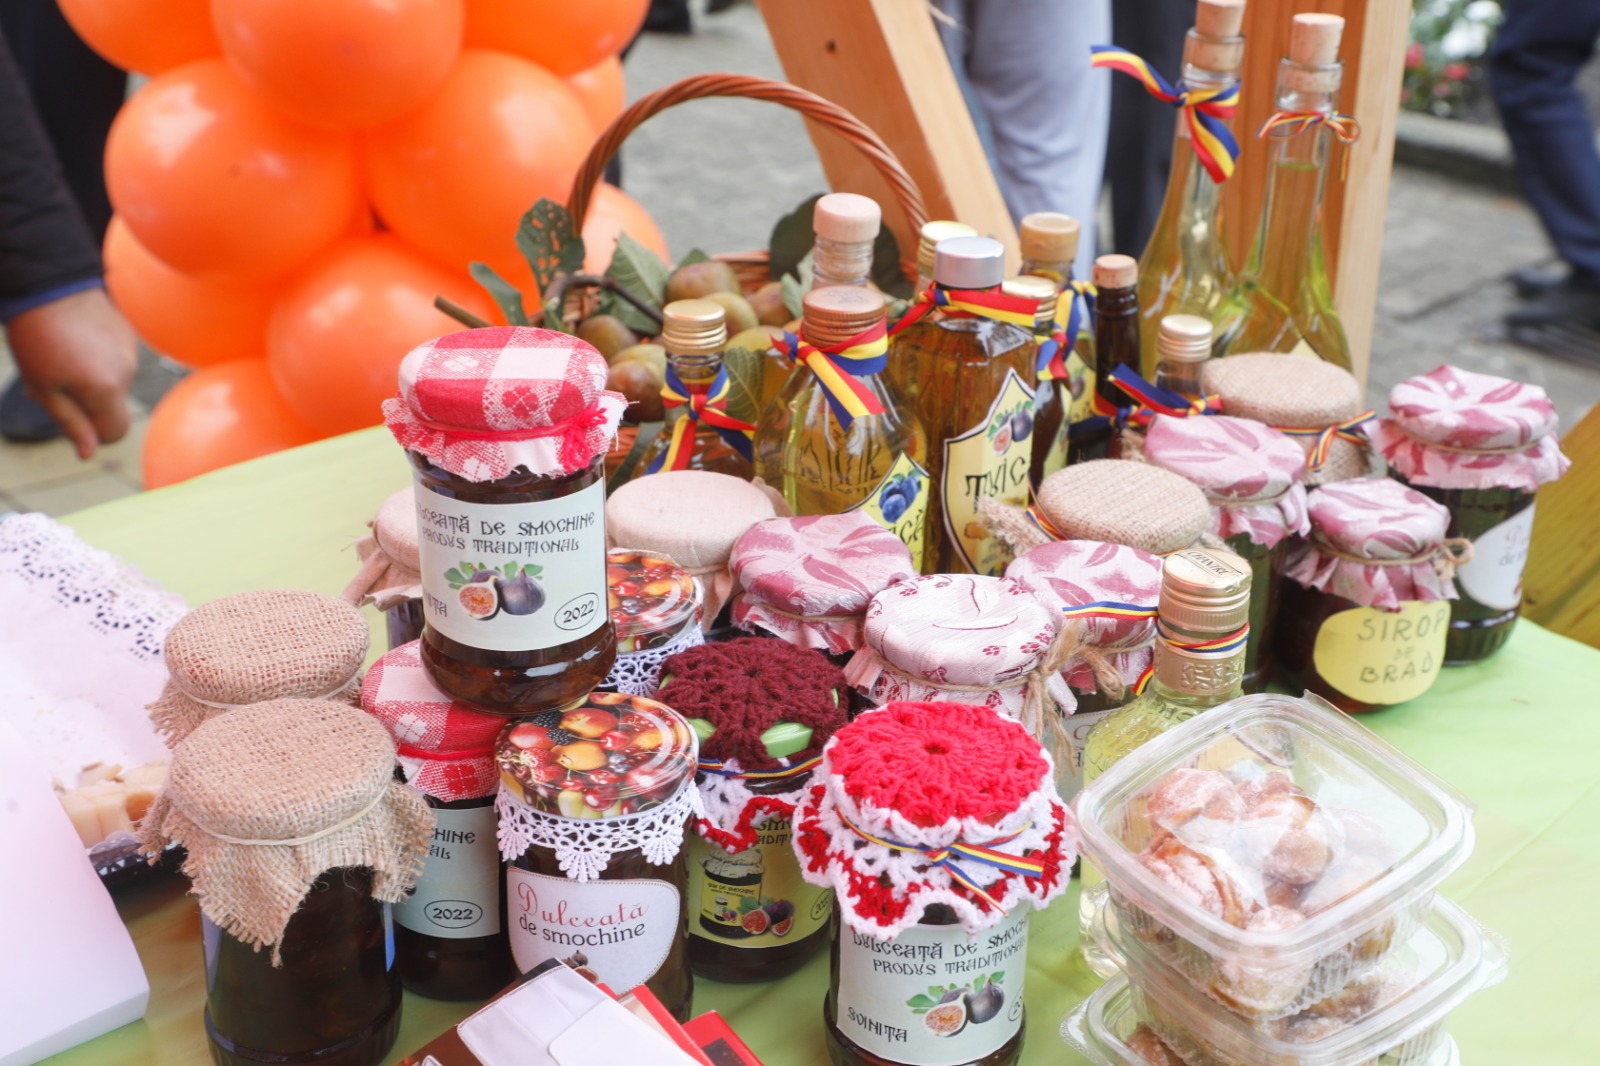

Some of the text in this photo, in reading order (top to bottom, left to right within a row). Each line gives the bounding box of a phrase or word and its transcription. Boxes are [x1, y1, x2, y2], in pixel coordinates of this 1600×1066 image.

[481, 521, 506, 536] DE
[516, 511, 595, 536] SMOCHINE
[563, 600, 594, 623] 2022
[1357, 608, 1446, 642] SIROP
[1360, 647, 1433, 683] BRAD
[432, 907, 478, 920] 2022
[519, 913, 646, 946] de smochine
[954, 943, 977, 957] DE
[873, 959, 936, 975] PRODUS
